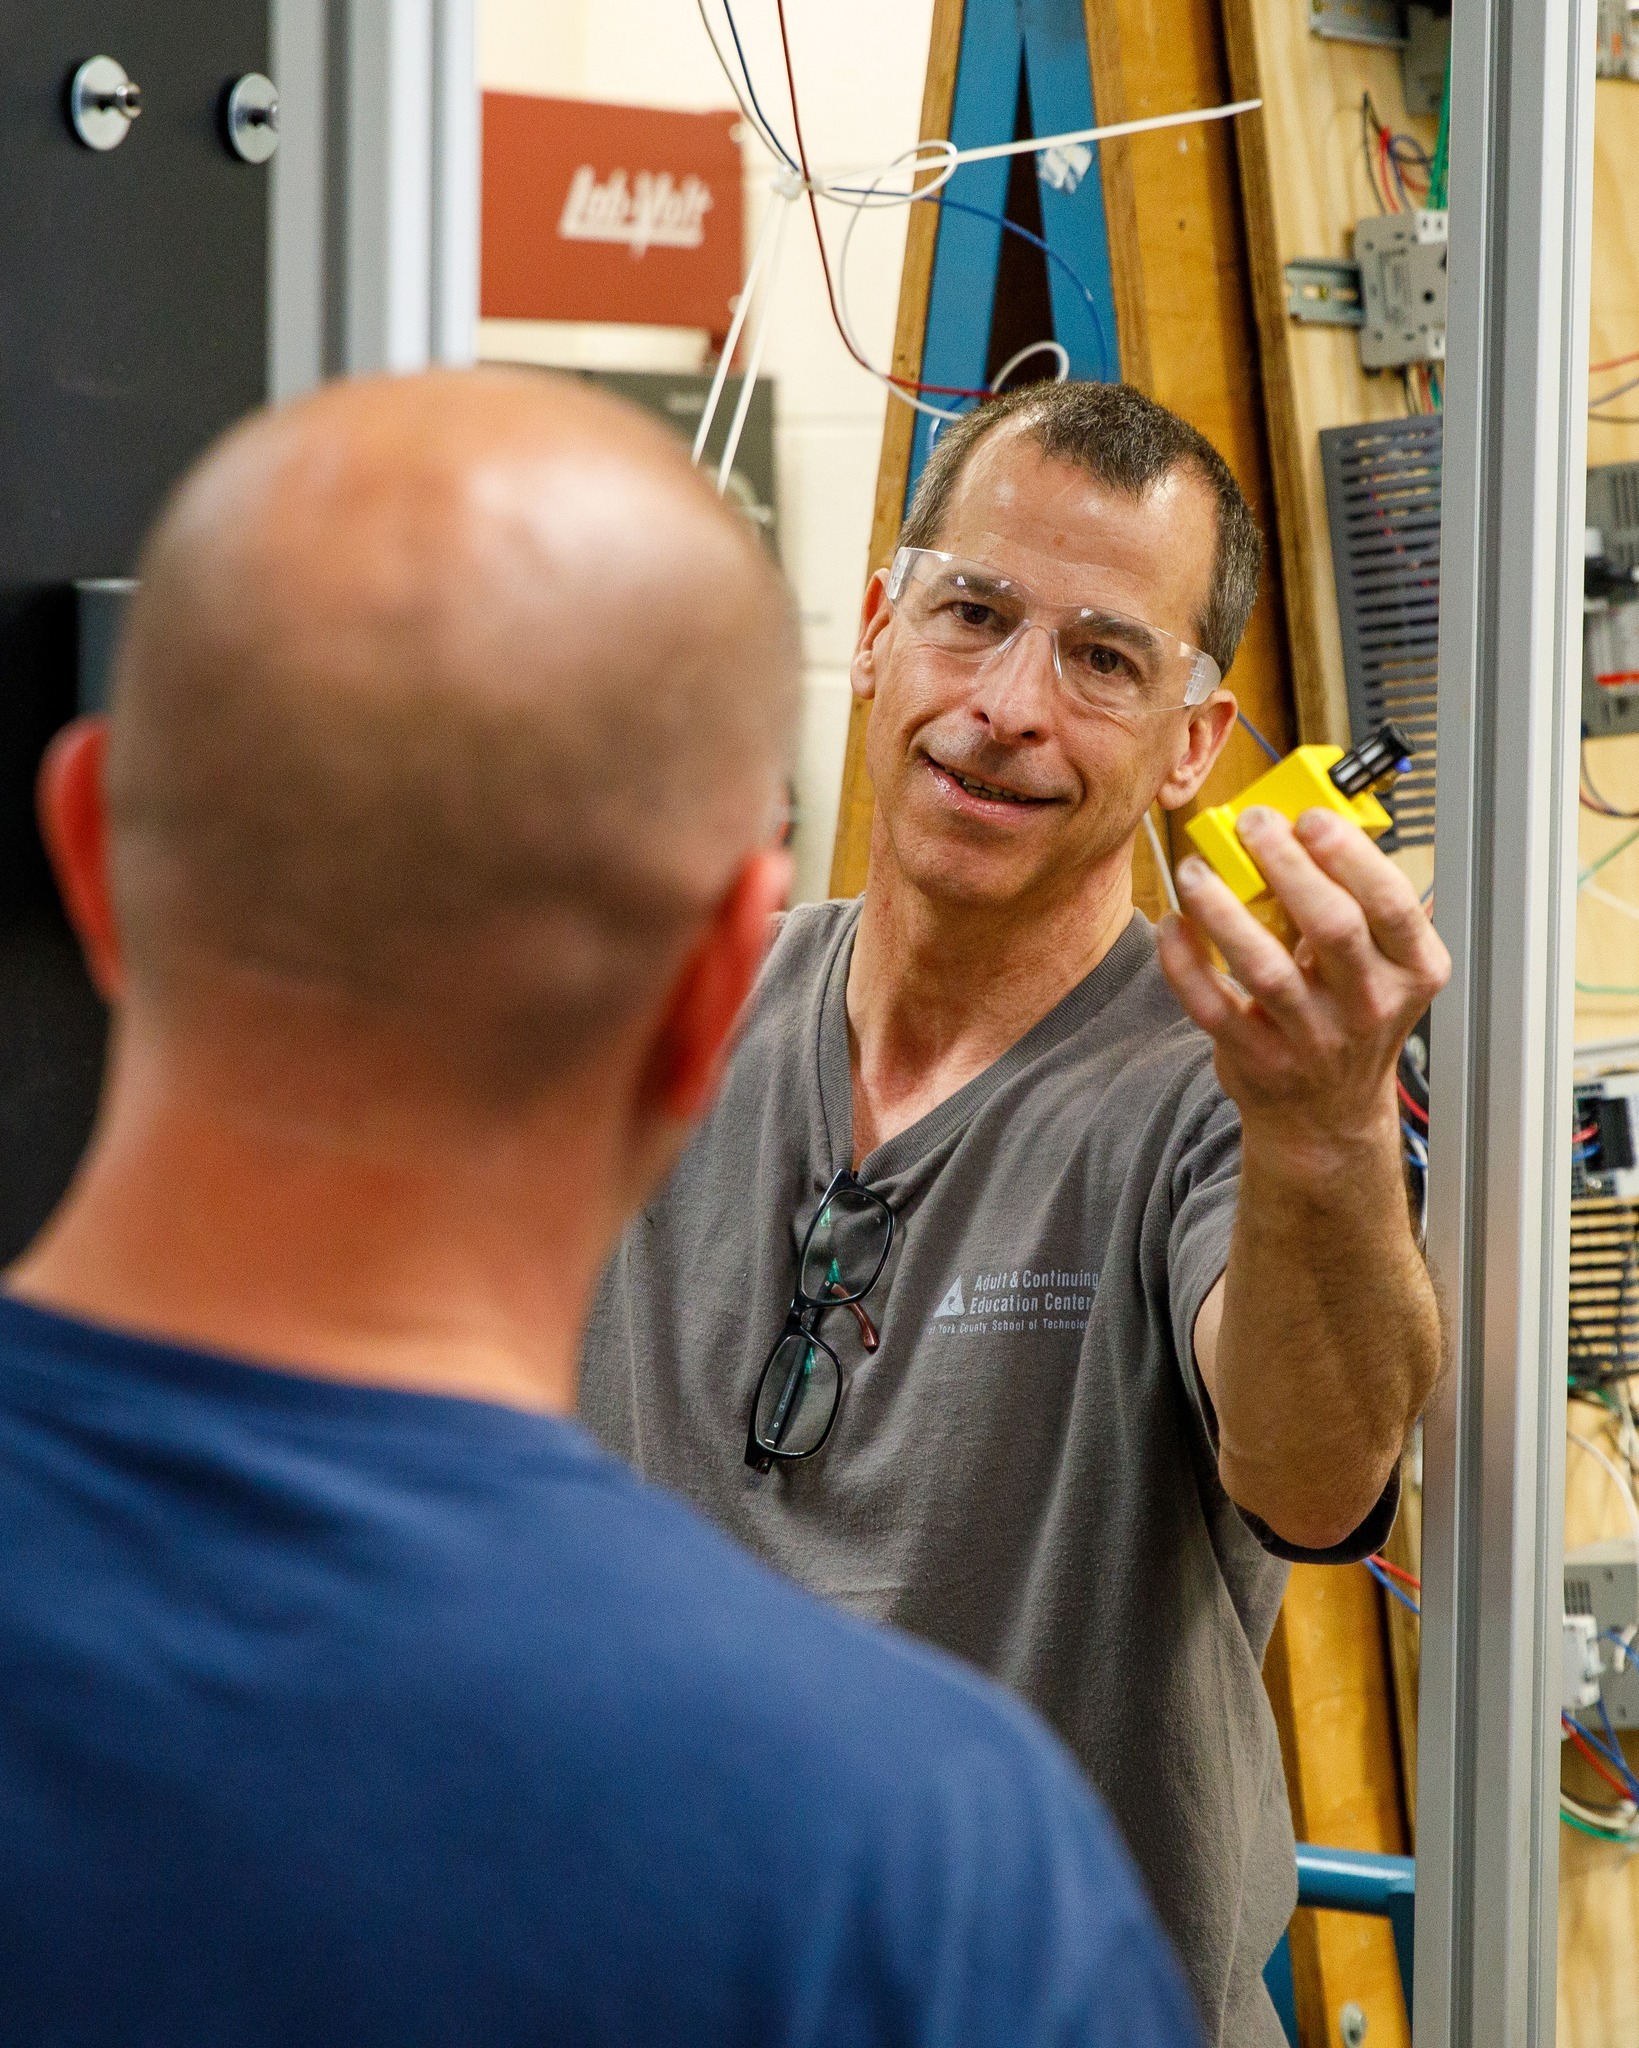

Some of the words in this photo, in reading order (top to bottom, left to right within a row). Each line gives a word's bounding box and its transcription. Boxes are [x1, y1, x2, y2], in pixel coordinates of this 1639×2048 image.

[974, 1273, 1008, 1292] Adult
[1010, 1271, 1018, 1288] &
[1022, 1269, 1099, 1290] Continuing
[970, 1295, 1038, 1315] Education
[1045, 1292, 1091, 1311] Center
[938, 1323, 955, 1334] York
[959, 1321, 988, 1335] County
[992, 1319, 1024, 1331] School
[1029, 1319, 1038, 1330] of
